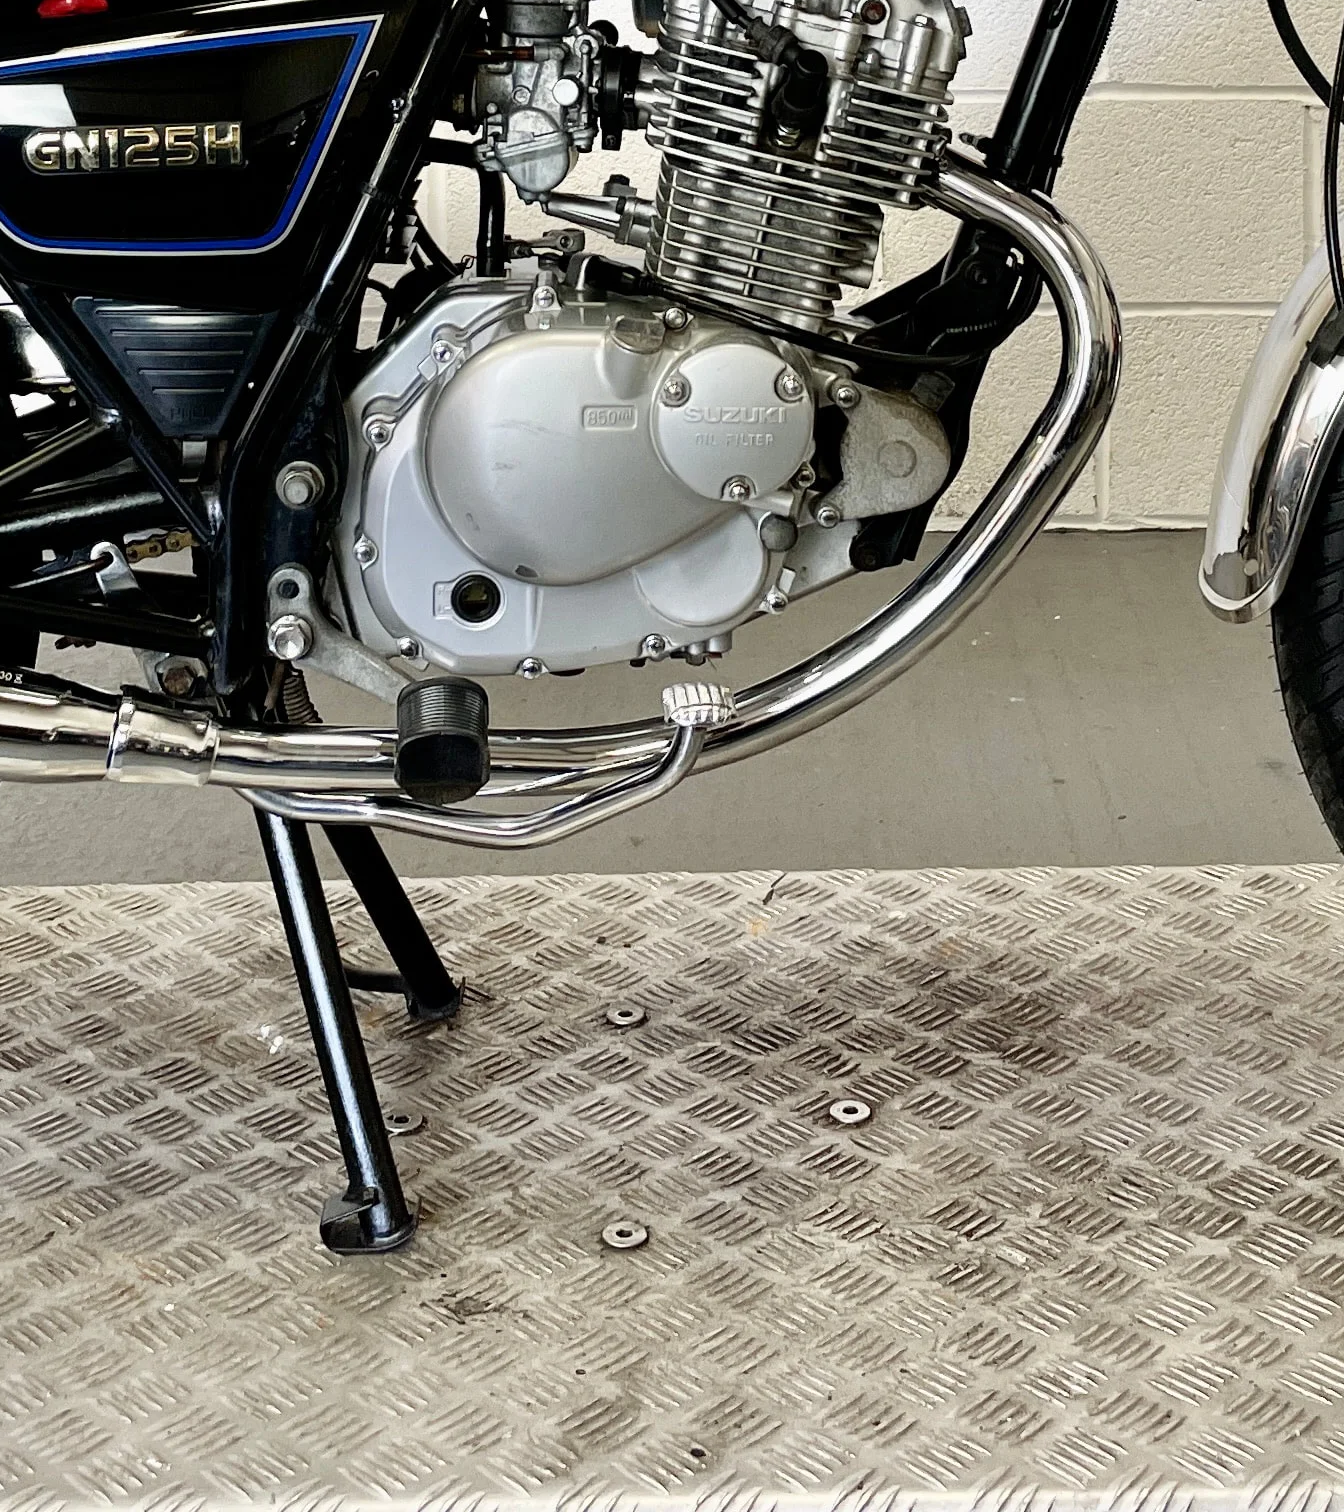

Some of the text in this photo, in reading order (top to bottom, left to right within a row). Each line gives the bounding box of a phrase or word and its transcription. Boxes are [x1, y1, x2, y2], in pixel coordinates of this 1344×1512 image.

[26, 123, 244, 173] GN125H
[683, 406, 787, 425] SUZUKI
[695, 432, 775, 448] OIL FILTER
